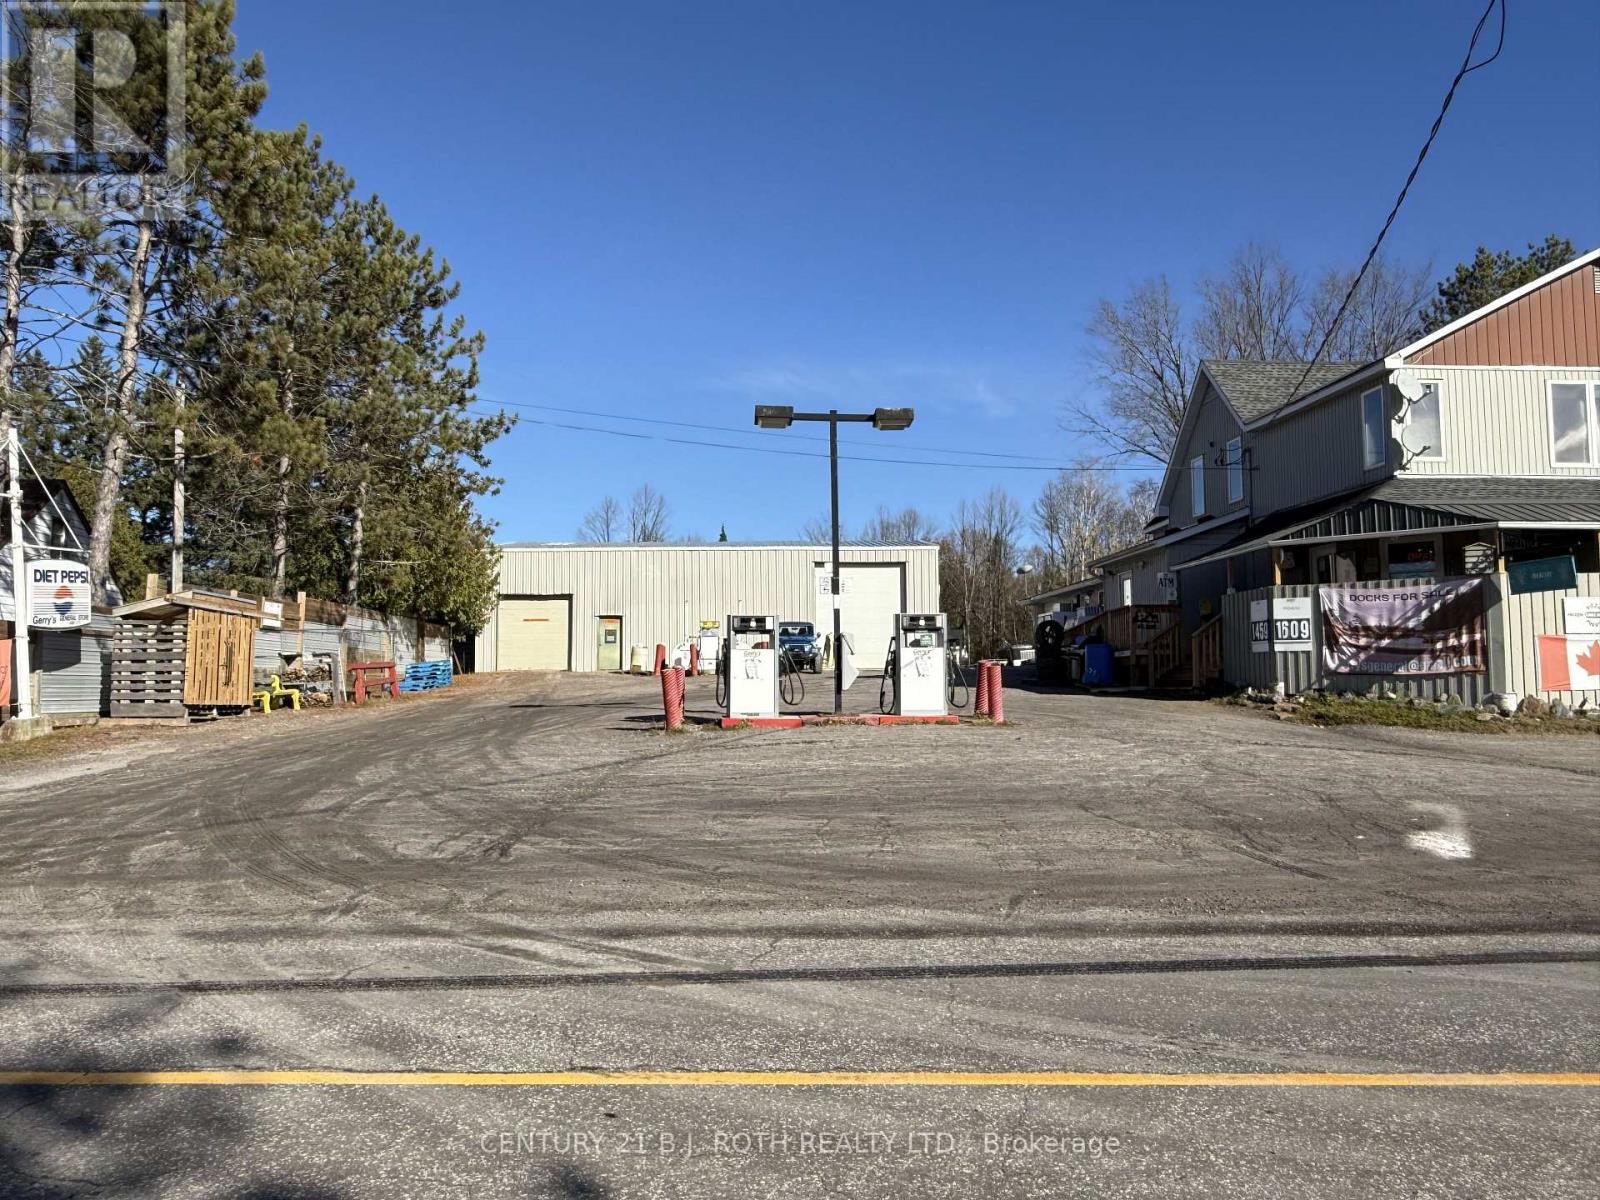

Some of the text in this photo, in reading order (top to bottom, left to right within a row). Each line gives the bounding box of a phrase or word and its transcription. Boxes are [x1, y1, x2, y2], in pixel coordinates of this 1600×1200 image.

[34, 569, 88, 583] DIET PEPSI
[1159, 578, 1174, 588] ATM
[1350, 594, 1389, 602] DOCKS
[1393, 593, 1417, 601] FOR
[33, 616, 56, 625] Gerry's
[1276, 620, 1309, 639] 1609
